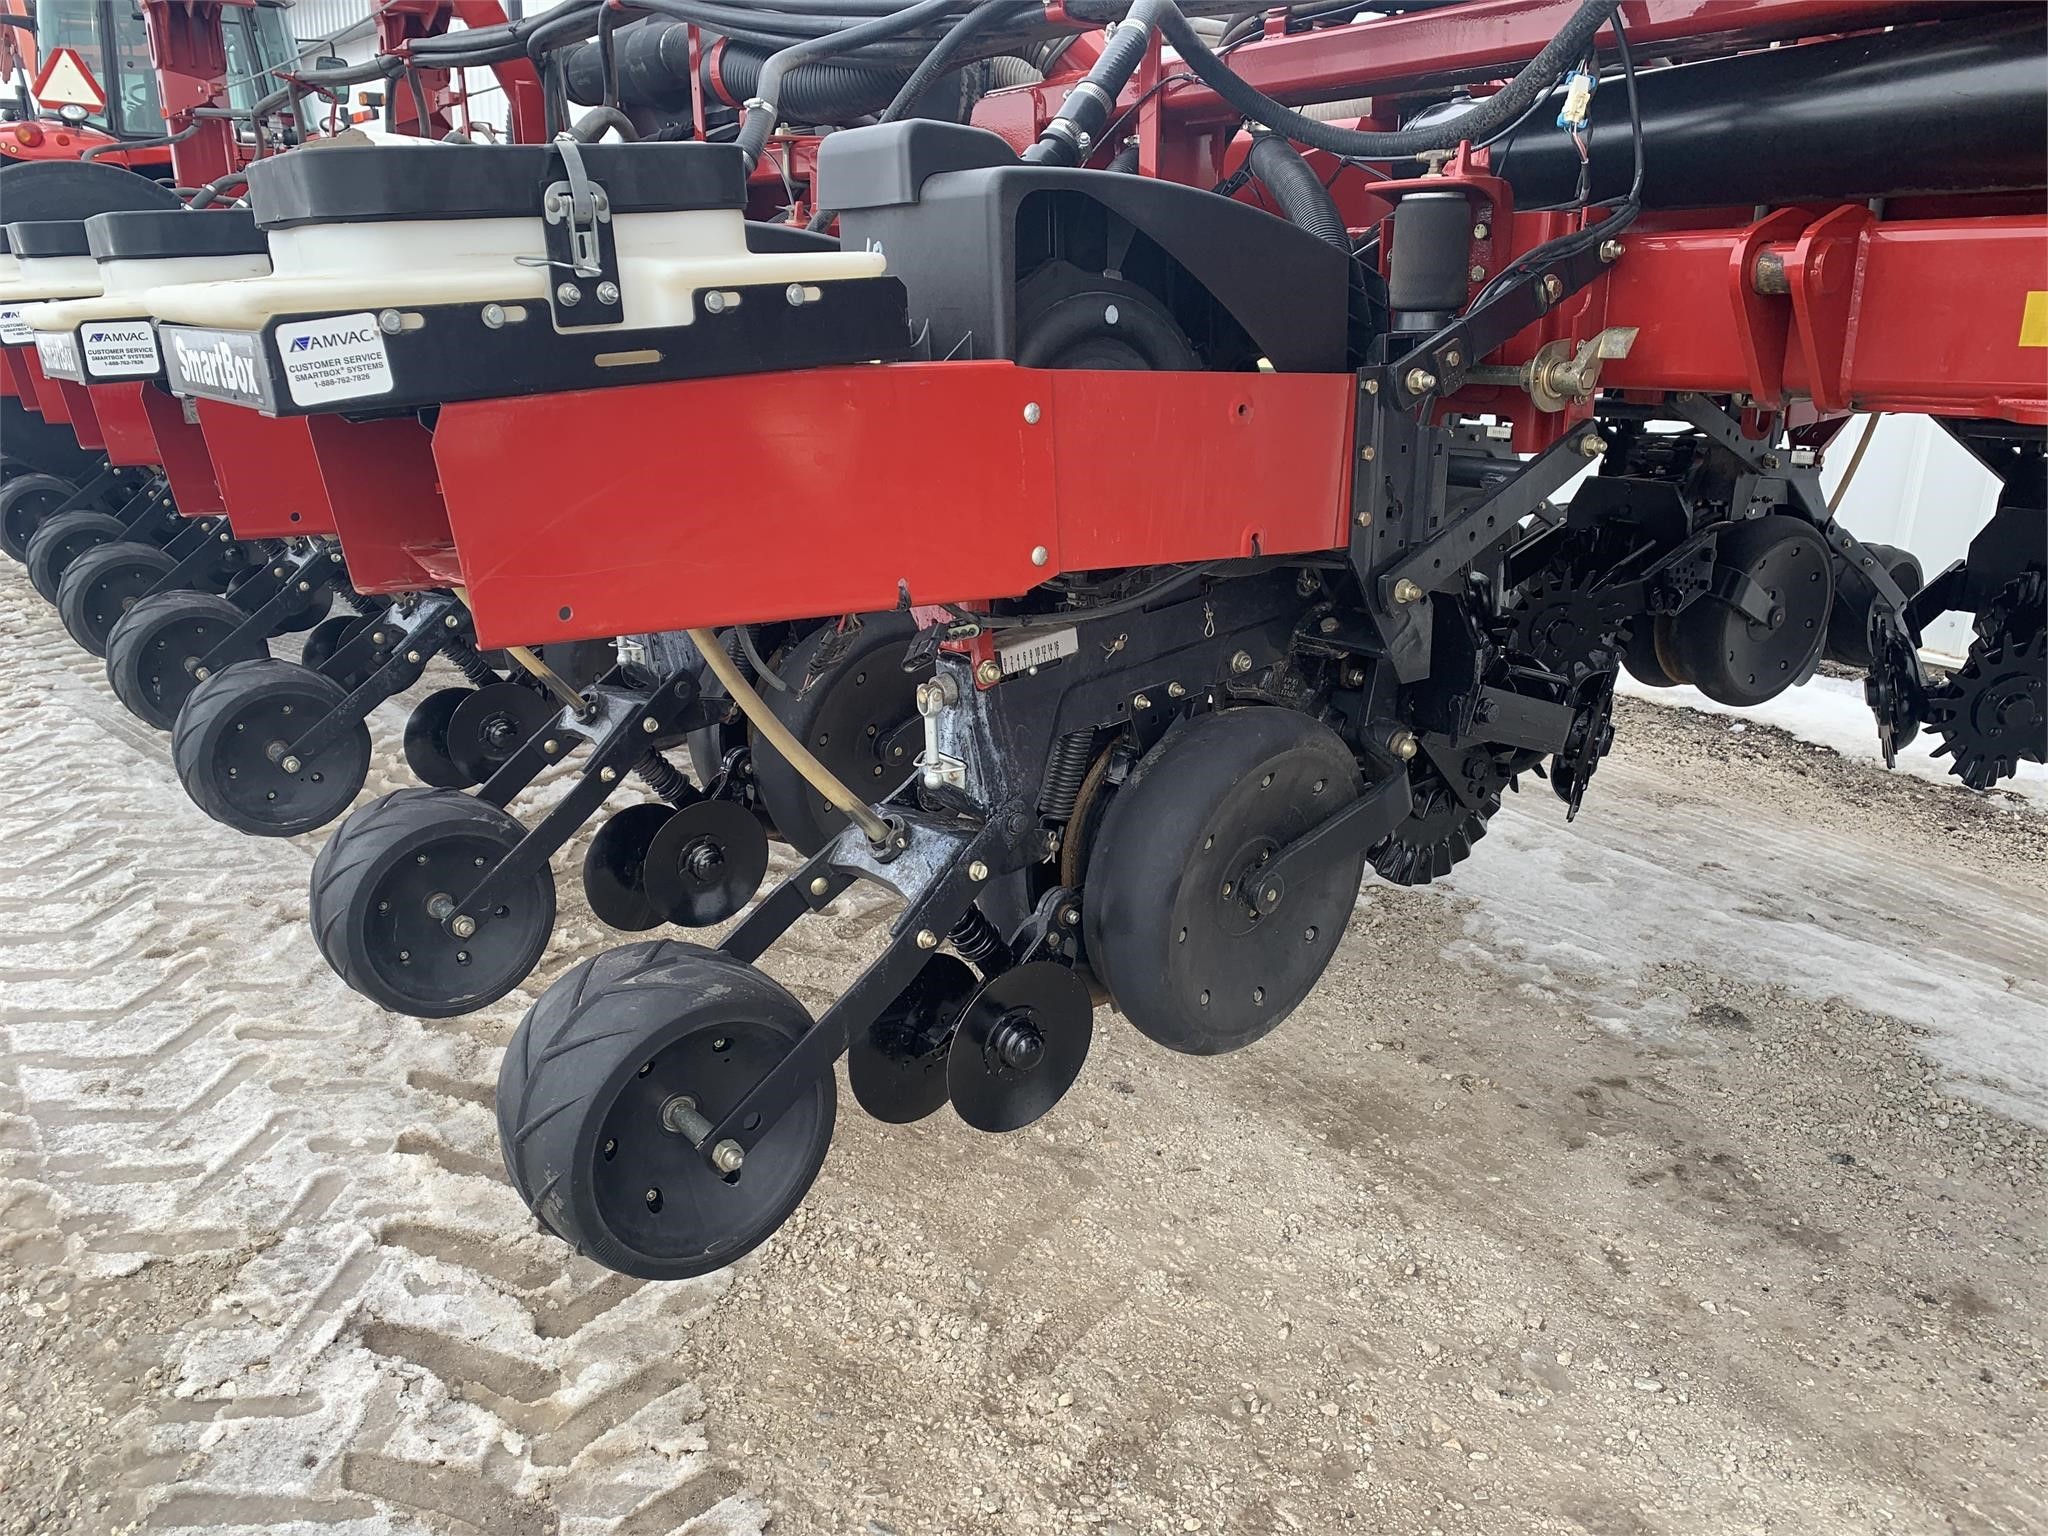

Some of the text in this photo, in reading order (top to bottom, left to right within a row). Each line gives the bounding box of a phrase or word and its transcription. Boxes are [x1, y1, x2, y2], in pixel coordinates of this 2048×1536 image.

[104, 331, 146, 342] AMVAC
[310, 329, 371, 351] AMVAC
[87, 346, 154, 356] CUSTOMER SERVICE
[175, 335, 260, 395] SmartBox
[288, 351, 383, 374] CUSTOMER SERVICE
[346, 361, 384, 374] SYSTEMS
[314, 373, 371, 388] 1-888-762-7826
